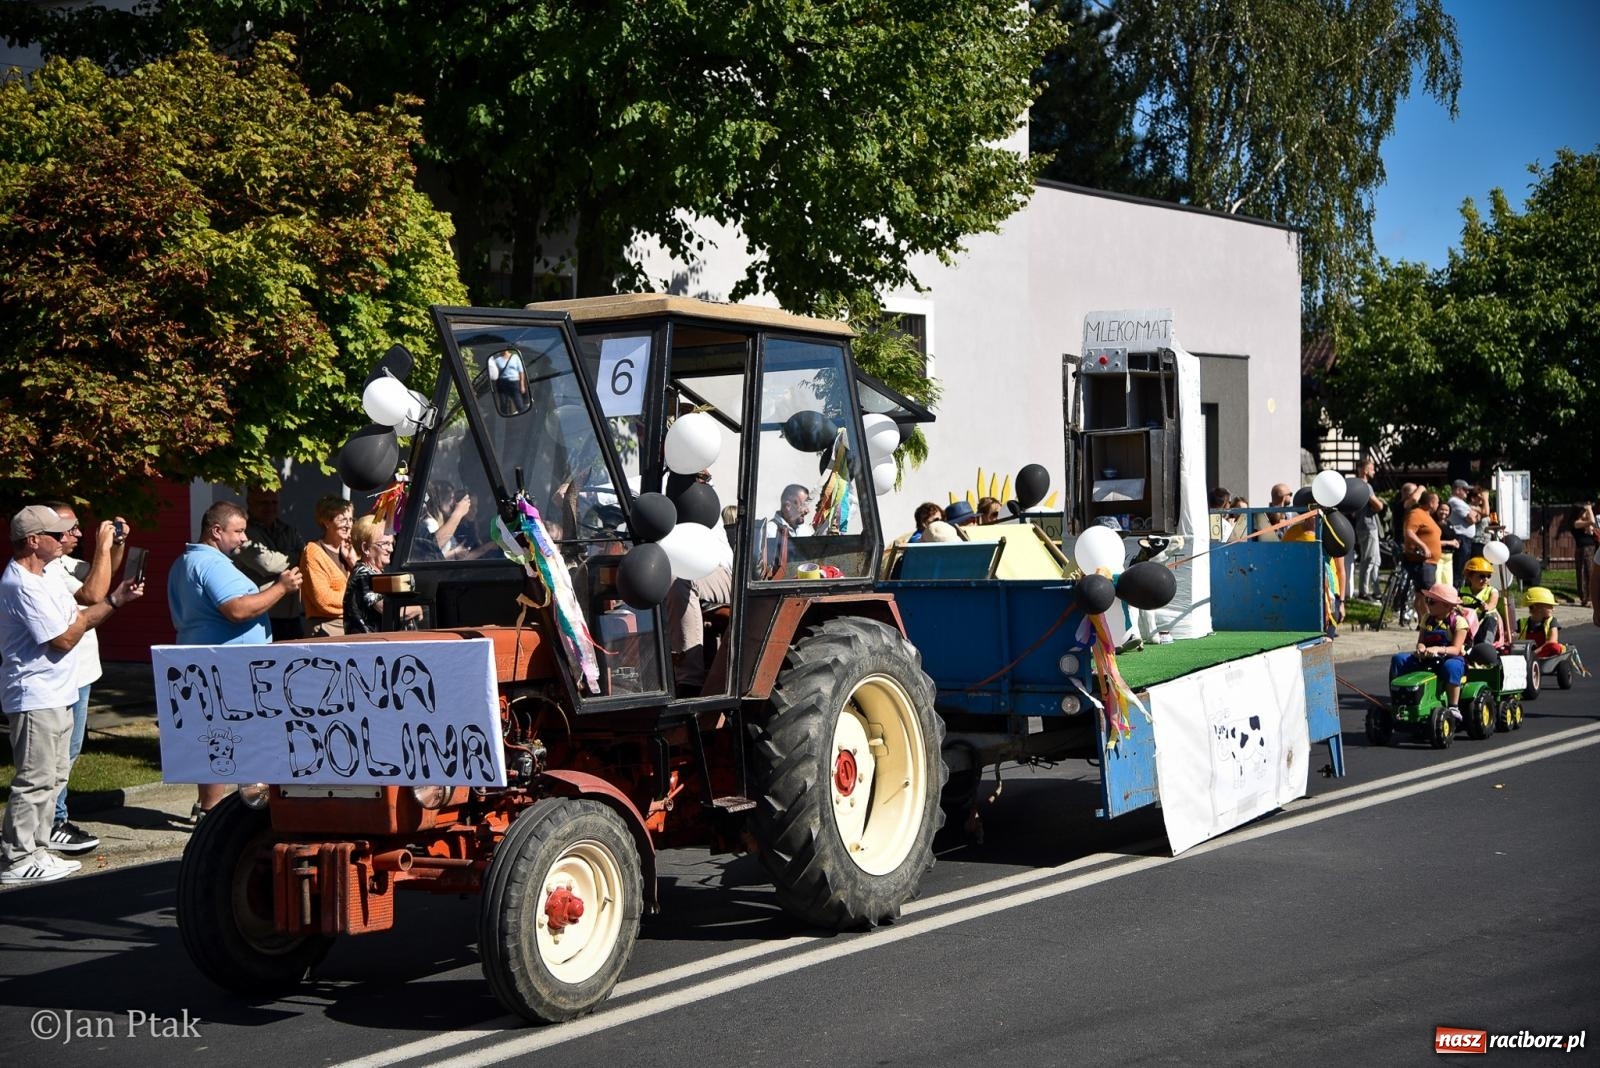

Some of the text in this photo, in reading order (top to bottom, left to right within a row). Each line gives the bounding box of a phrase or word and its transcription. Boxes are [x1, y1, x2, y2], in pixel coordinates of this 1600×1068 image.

[1085, 319, 1173, 342] MLEKOMAT
[611, 358, 635, 396] 6
[166, 654, 436, 729] MLECZNA
[285, 716, 496, 783] DOLINA
